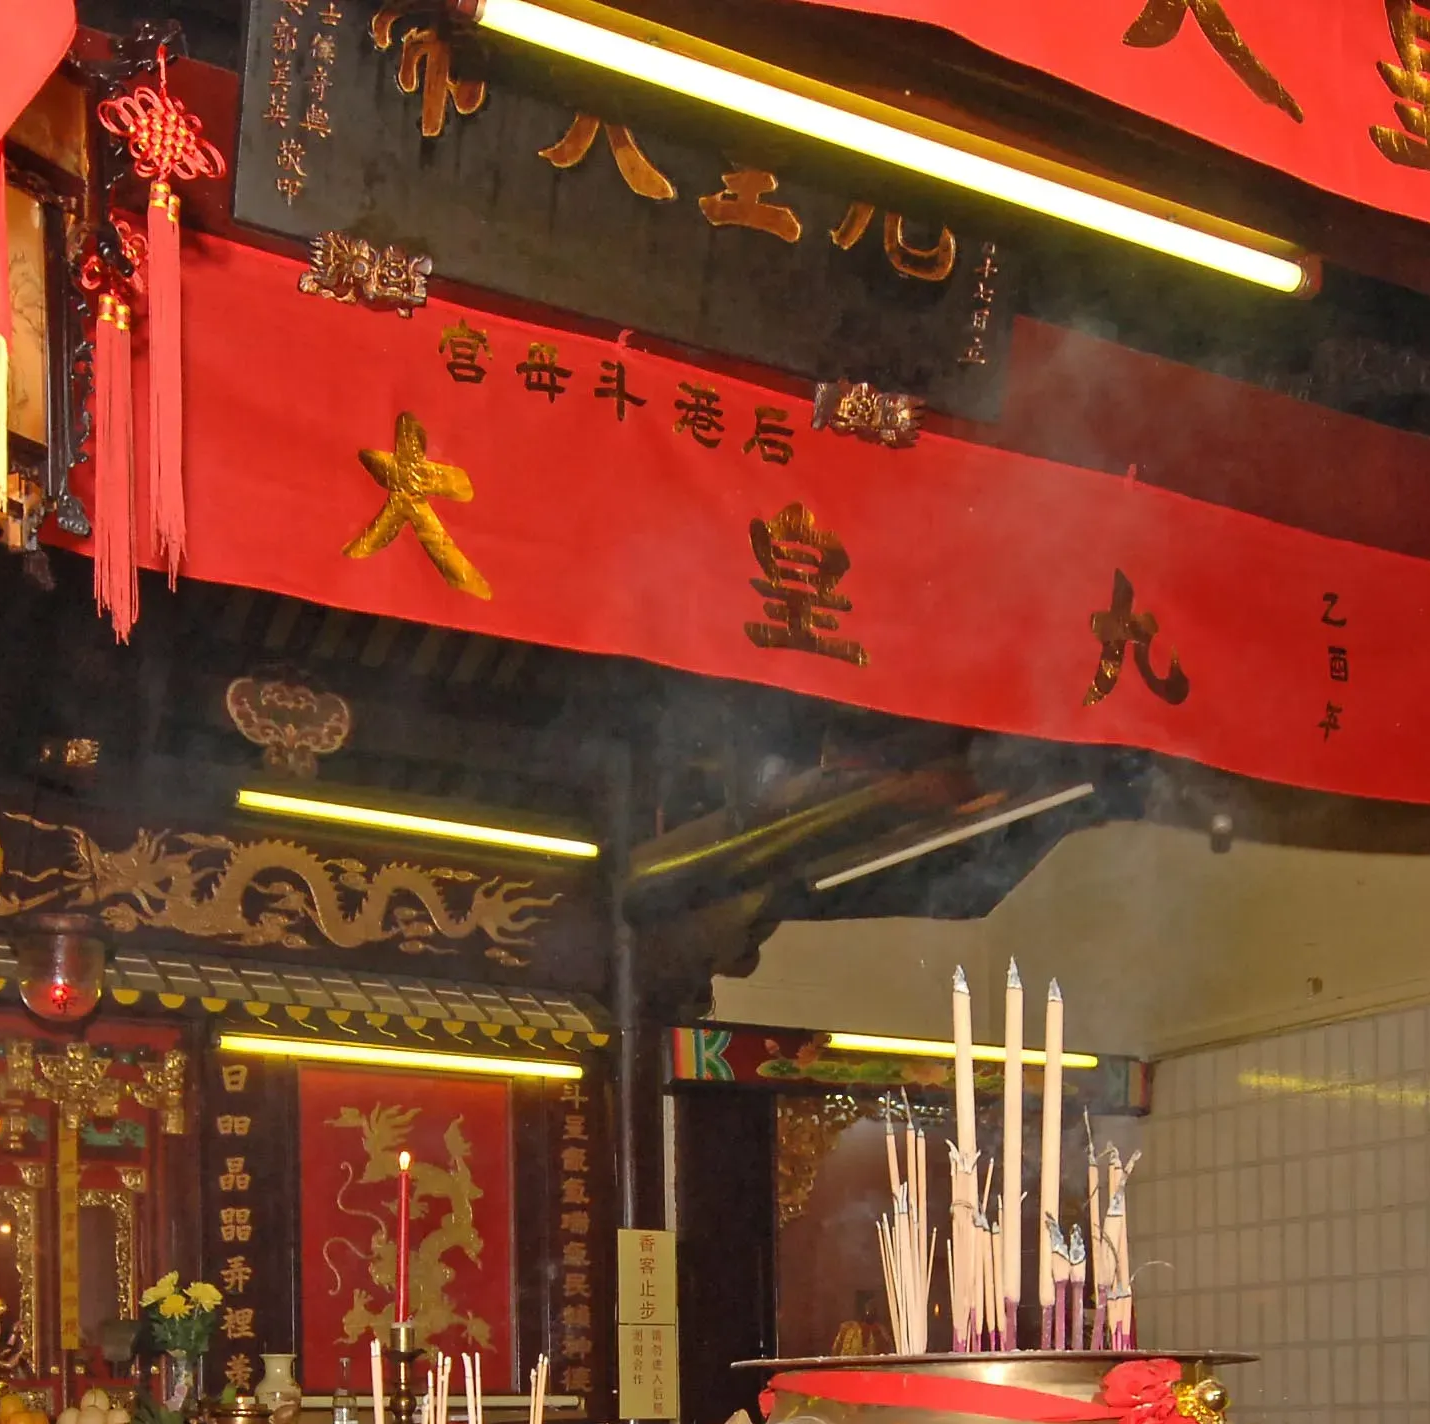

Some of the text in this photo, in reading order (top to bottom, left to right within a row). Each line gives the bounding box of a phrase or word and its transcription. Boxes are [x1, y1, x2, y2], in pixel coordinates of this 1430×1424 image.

[1317, 592, 1348, 742] 乙酉年
[639, 1234, 656, 1320] 香客止步
